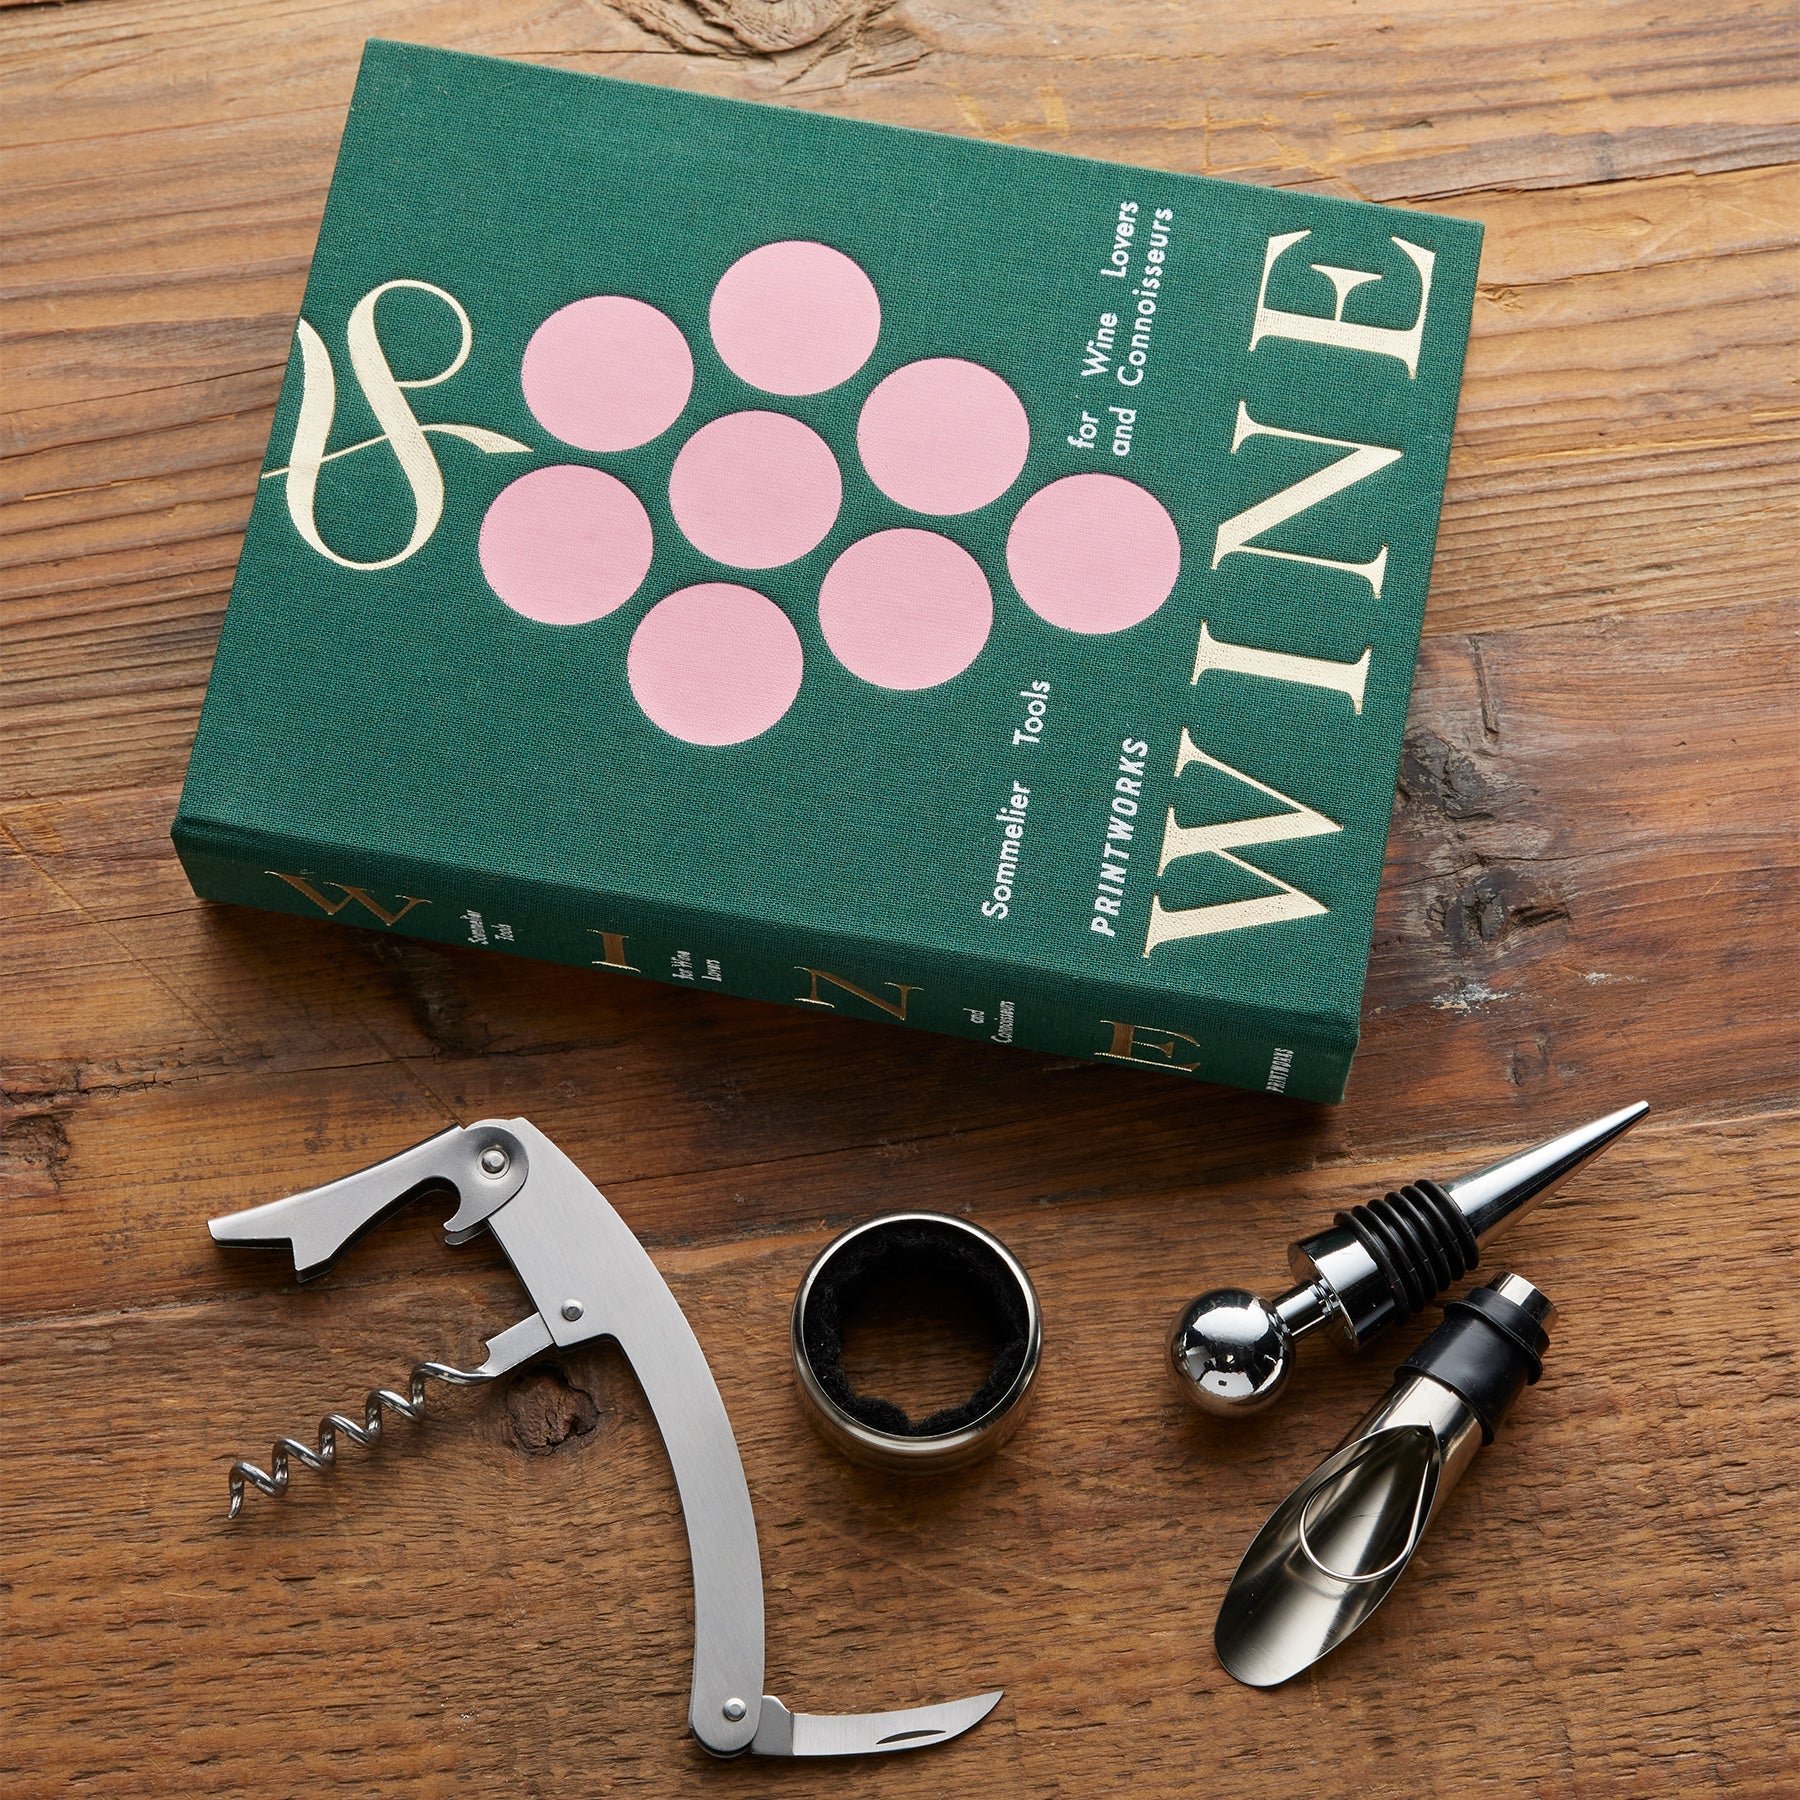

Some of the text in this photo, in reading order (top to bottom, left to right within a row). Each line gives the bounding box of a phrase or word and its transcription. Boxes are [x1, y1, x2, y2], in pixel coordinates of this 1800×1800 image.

[1067, 200, 1139, 449] for Wine Lovers
[1111, 206, 1174, 456] and Connoisseurs
[1143, 229, 1437, 959] WINE
[981, 679, 1051, 920] Sommelier Tools
[1090, 737, 1149, 938] PRINTWORKS
[963, 1008, 985, 1024] and
[1266, 1047, 1294, 1093] PRINTWORKS
